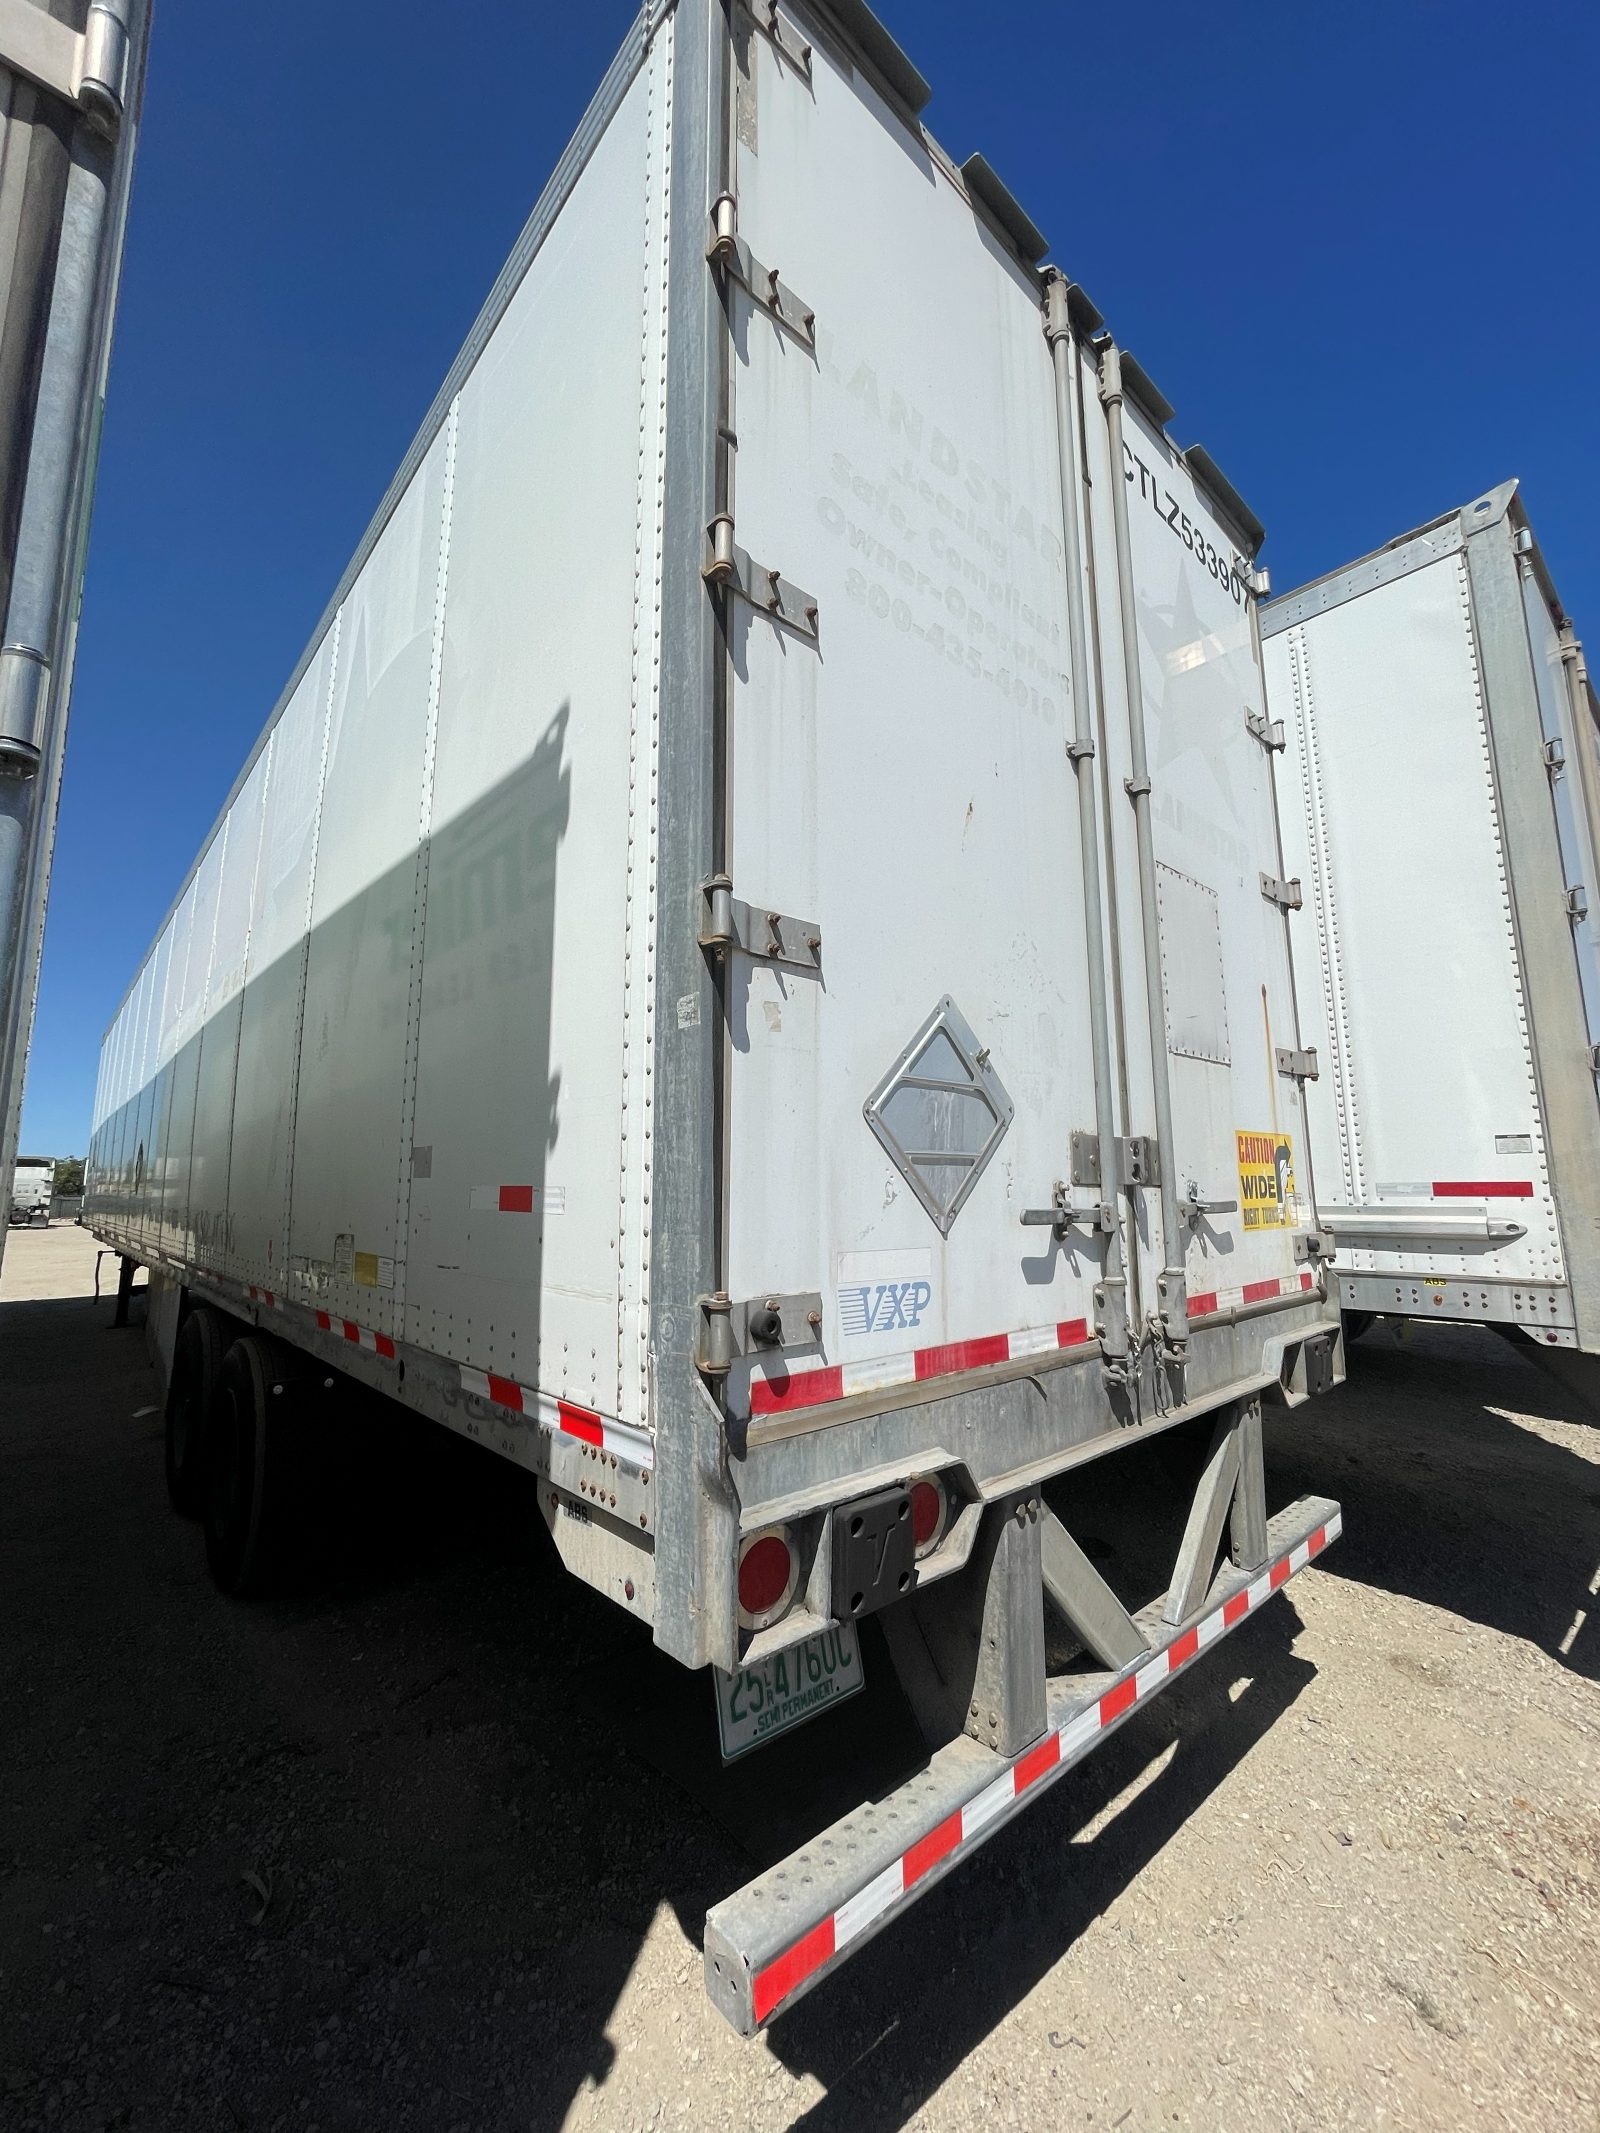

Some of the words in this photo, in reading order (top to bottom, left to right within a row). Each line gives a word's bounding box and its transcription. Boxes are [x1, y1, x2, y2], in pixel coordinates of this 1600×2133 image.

[1237, 1135, 1275, 1165] CAUTION
[1241, 1175, 1276, 1200] WIDE
[1424, 1277, 1447, 1286] ABS
[858, 1281, 932, 1333] VXP
[757, 1704, 782, 1733] SEMI
[782, 1678, 835, 1720] PERMANENT
